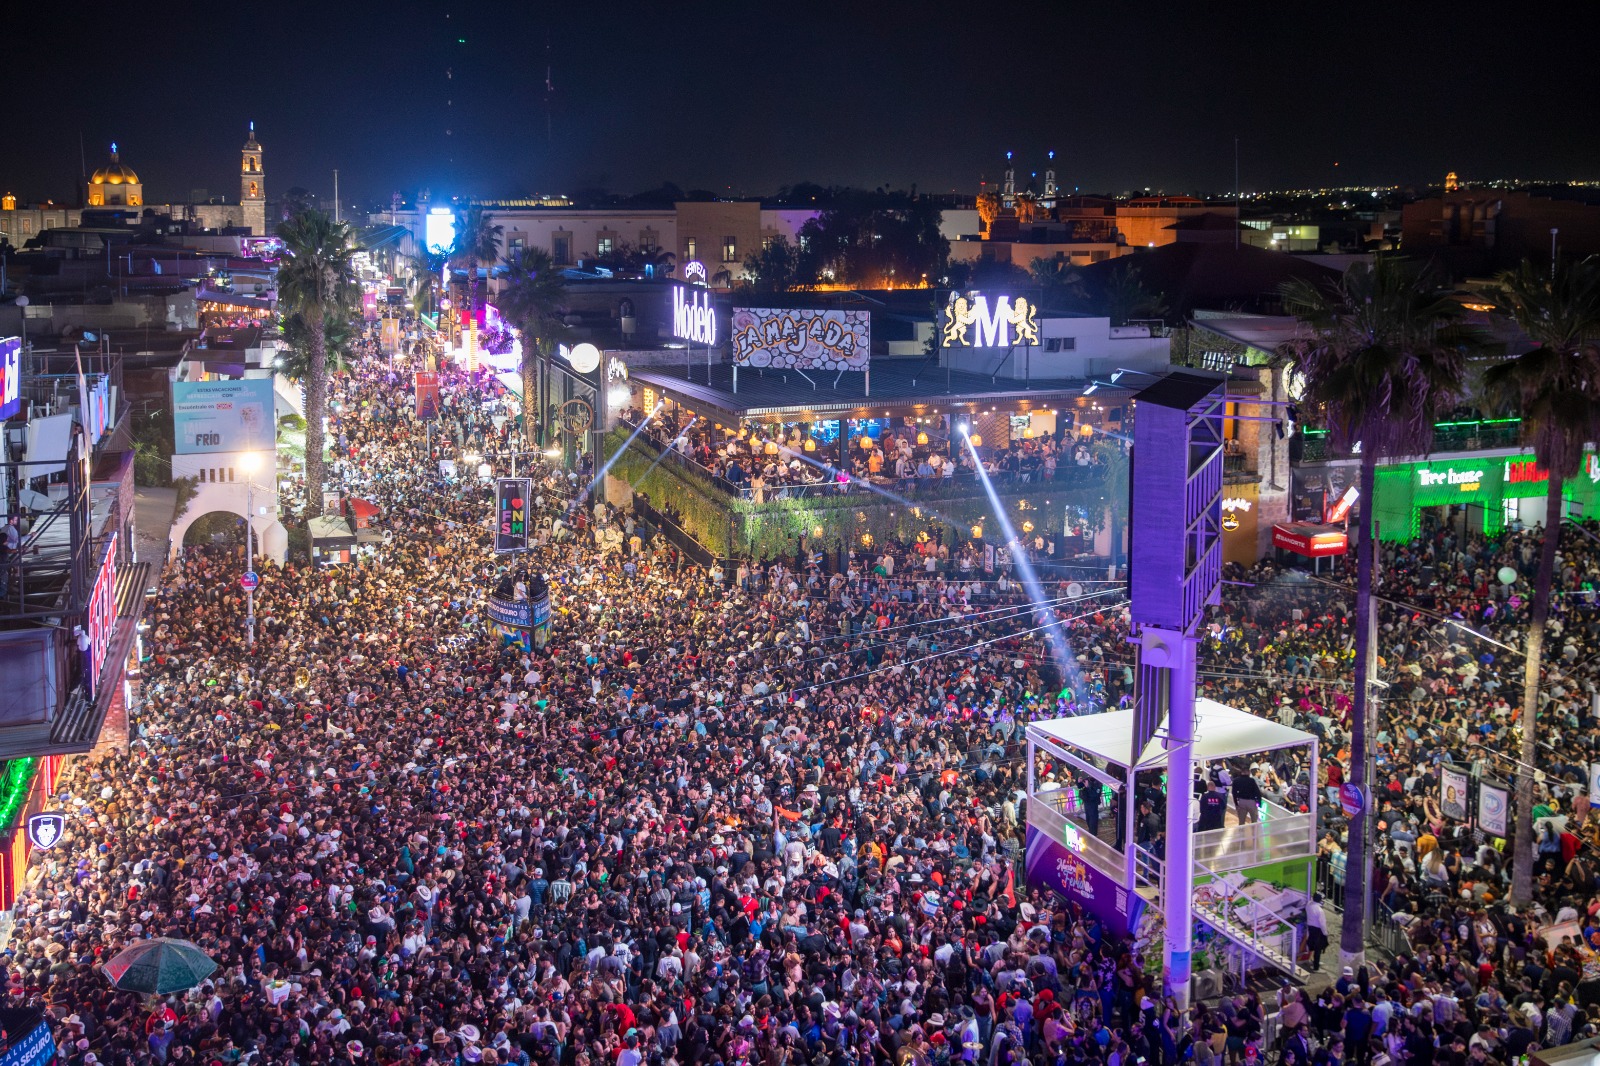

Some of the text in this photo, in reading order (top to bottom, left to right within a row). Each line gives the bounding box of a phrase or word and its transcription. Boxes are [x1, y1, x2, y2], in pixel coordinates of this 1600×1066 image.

[685, 261, 706, 281] CERVEZA
[673, 286, 716, 345] Modelo
[974, 296, 1010, 347] M
[737, 316, 855, 361] LA MAJADA
[195, 430, 220, 446] FRÍO
[1418, 468, 1483, 486] Tree house
[1460, 483, 1480, 491] ROOF
[502, 498, 507, 510] I
[1281, 534, 1305, 548] BANORTE
[20, 1031, 51, 1066] SEGURO
